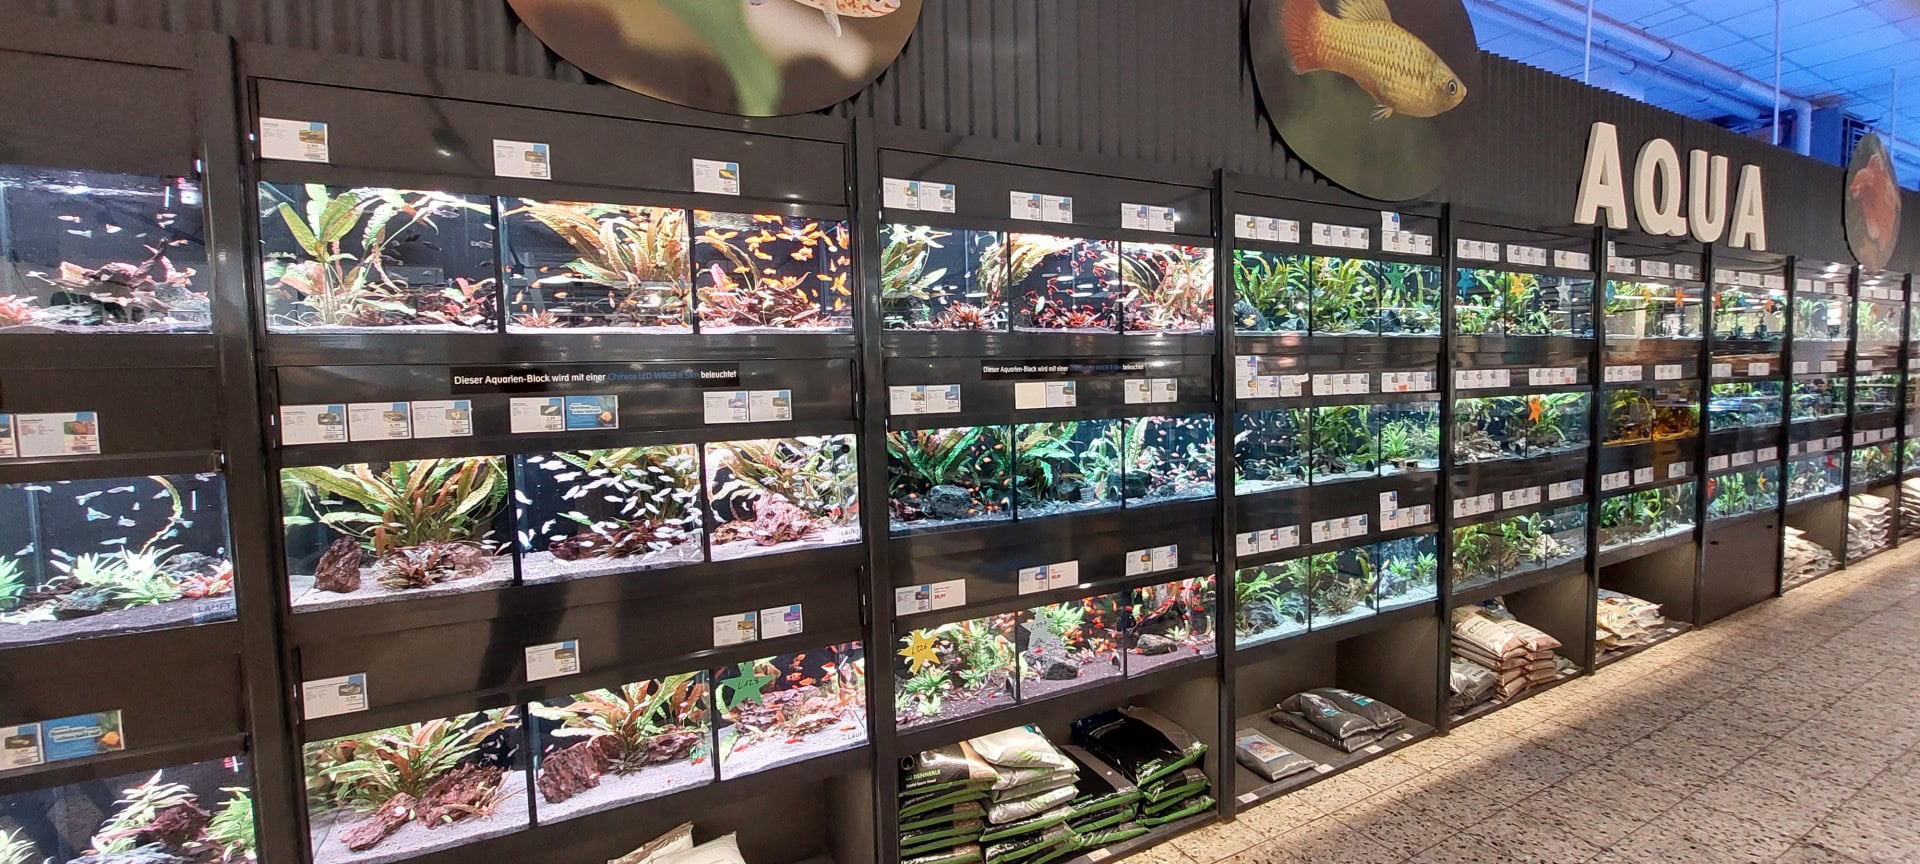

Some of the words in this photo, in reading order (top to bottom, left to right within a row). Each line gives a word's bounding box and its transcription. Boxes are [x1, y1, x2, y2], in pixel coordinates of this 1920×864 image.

[1574, 122, 1766, 251] AQUA
[983, 365, 1000, 373] Dieser
[1000, 365, 1037, 374] Aquarien-Block
[454, 375, 483, 385] Dieser
[485, 374, 550, 386] Aquarien-Block
[552, 373, 570, 382] wird
[571, 373, 584, 382] mit
[585, 372, 606, 381] einer
[639, 372, 652, 380] LED
[700, 370, 737, 379] beleuchtet
[912, 769, 941, 780] DENNERLE
